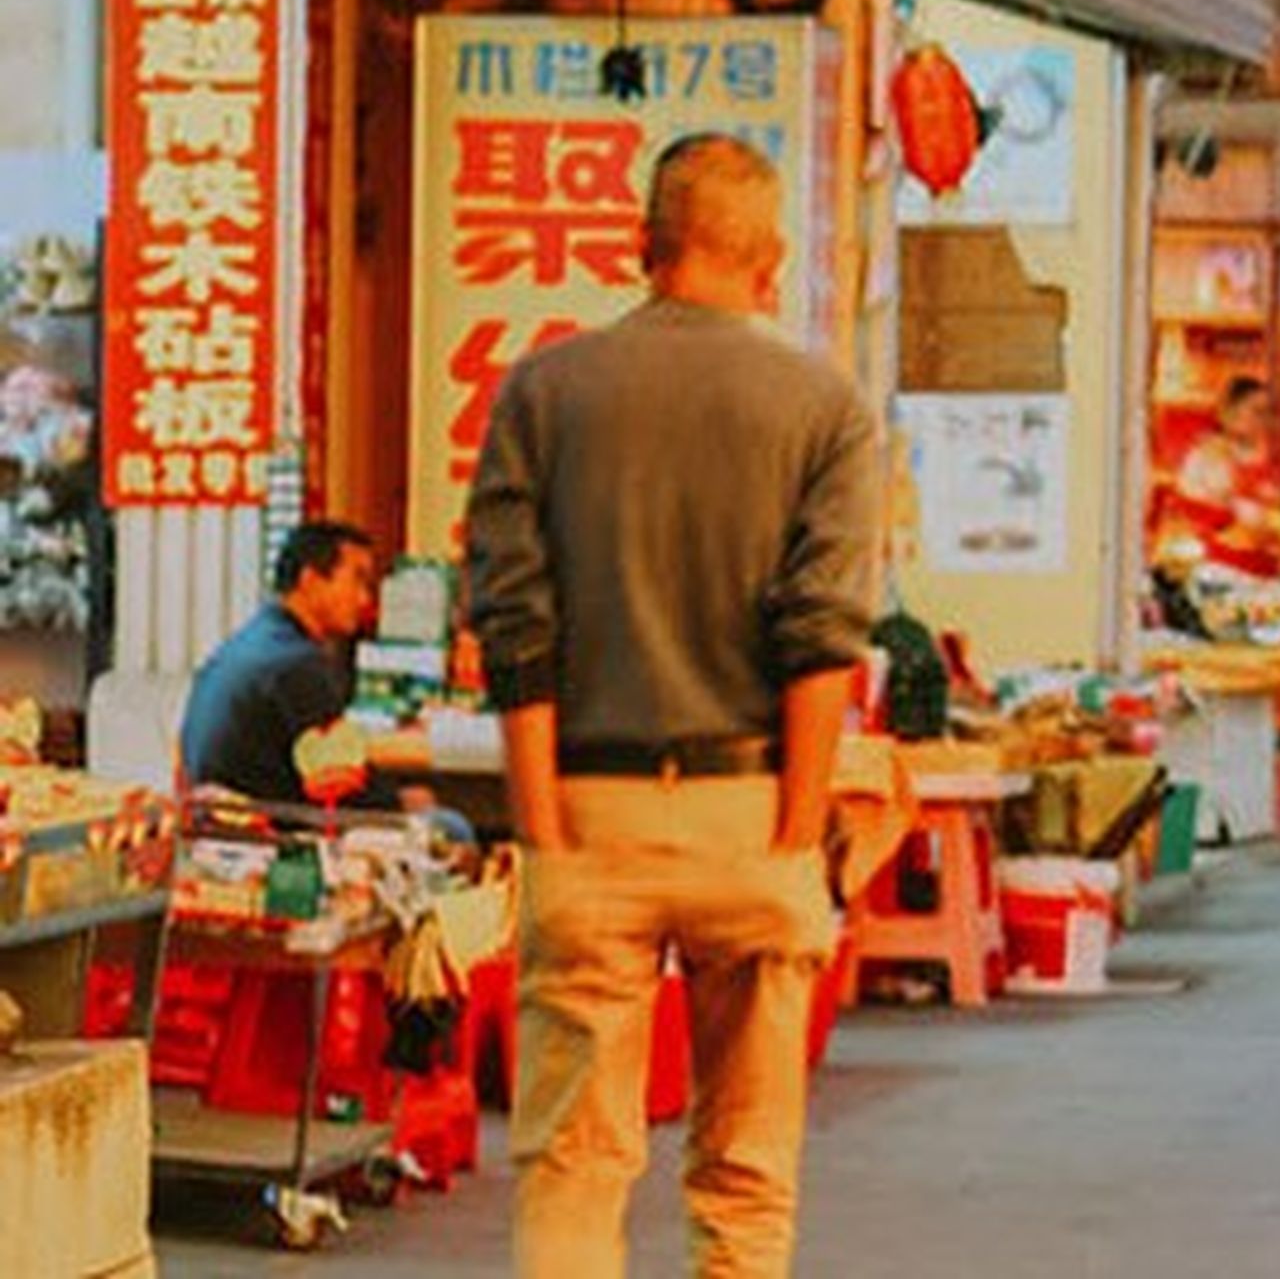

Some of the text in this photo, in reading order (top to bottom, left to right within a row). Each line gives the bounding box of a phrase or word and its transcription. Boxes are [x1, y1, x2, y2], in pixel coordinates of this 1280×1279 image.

[456, 43, 777, 99] 木栏17号
[135, 12, 262, 449] 越南铁木砧板
[453, 119, 645, 286] 聚
